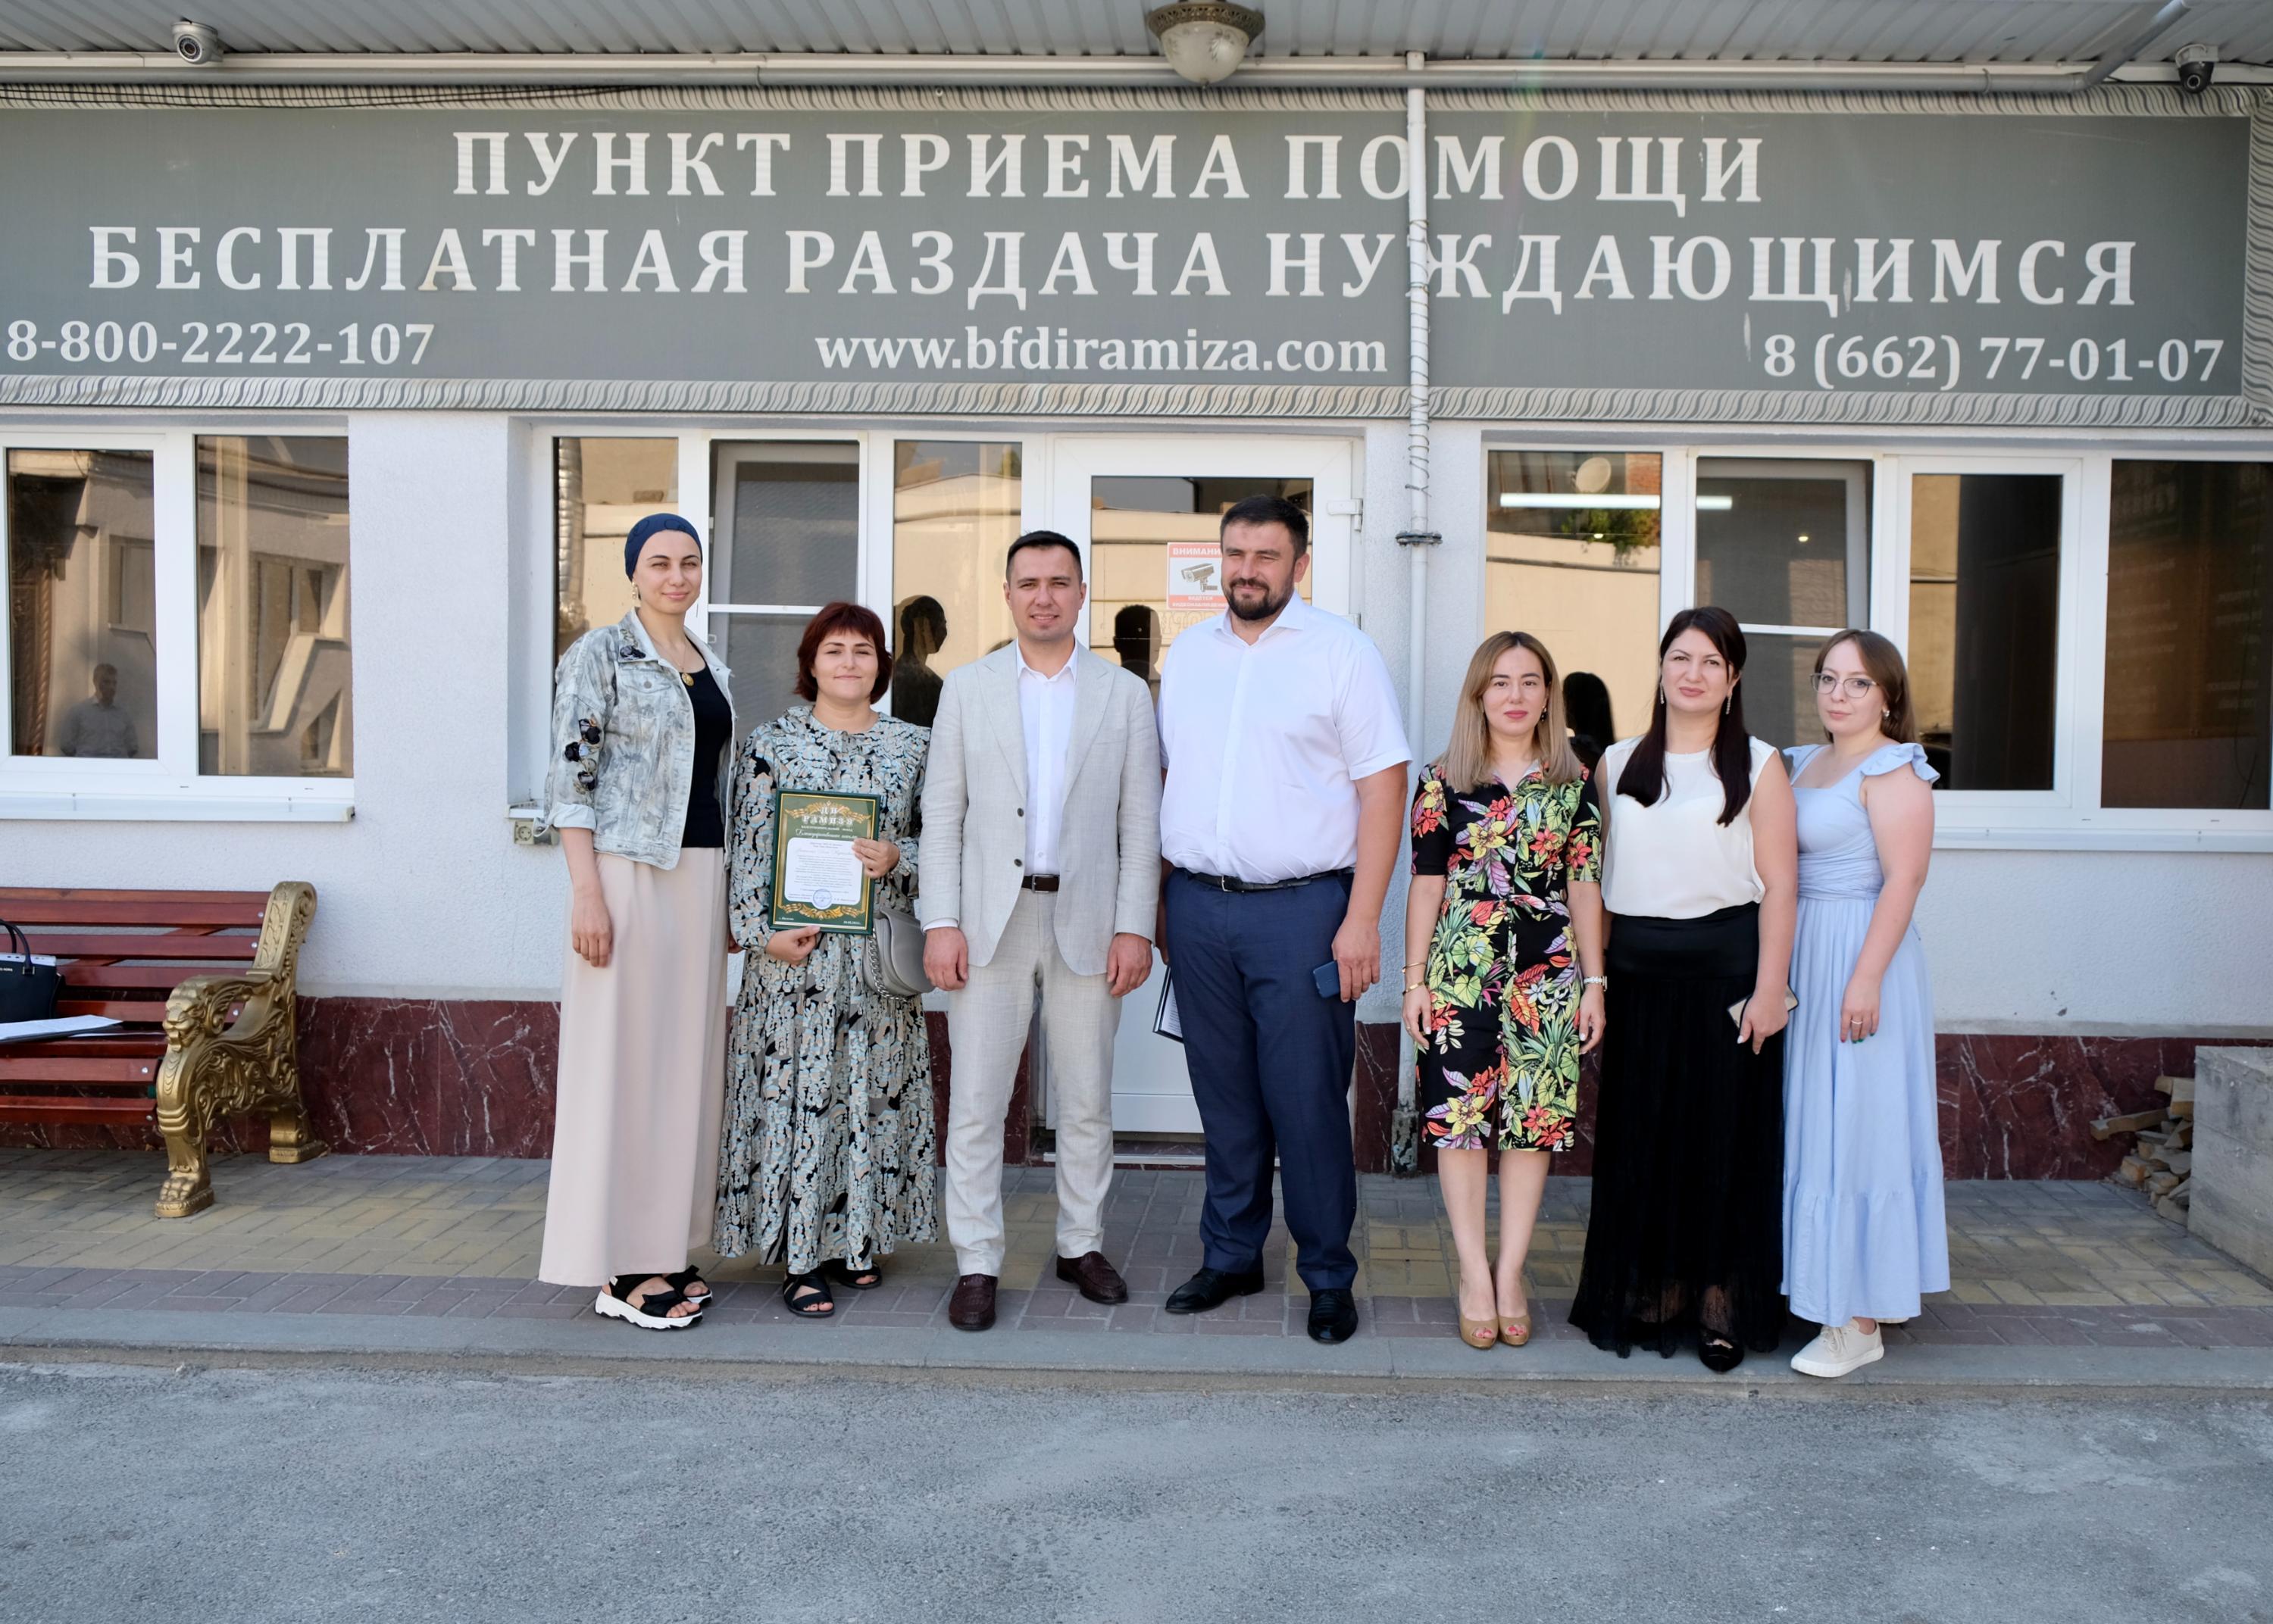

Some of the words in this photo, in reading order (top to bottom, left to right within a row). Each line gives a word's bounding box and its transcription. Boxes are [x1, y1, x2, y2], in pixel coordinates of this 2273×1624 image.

[453, 132, 790, 196] ПУНКТ
[825, 133, 1250, 198] ПРИЕМА
[1283, 135, 1762, 217] ПОМОЩИ
[89, 226, 749, 293] БЕСПЛАТНАЯ
[785, 230, 1231, 311] РАЗДАЧА
[1265, 233, 2136, 318] НУЖДАЮЩИМСЯ
[7, 320, 435, 365] 8-800-2222-107
[814, 326, 1388, 372] www.bfdiramiza.com
[1764, 334, 1796, 377] 8
[1814, 333, 1960, 390] (662)
[1979, 336, 2224, 382] 77-01-07
[1172, 547, 1221, 555] ВНИМАНИ
